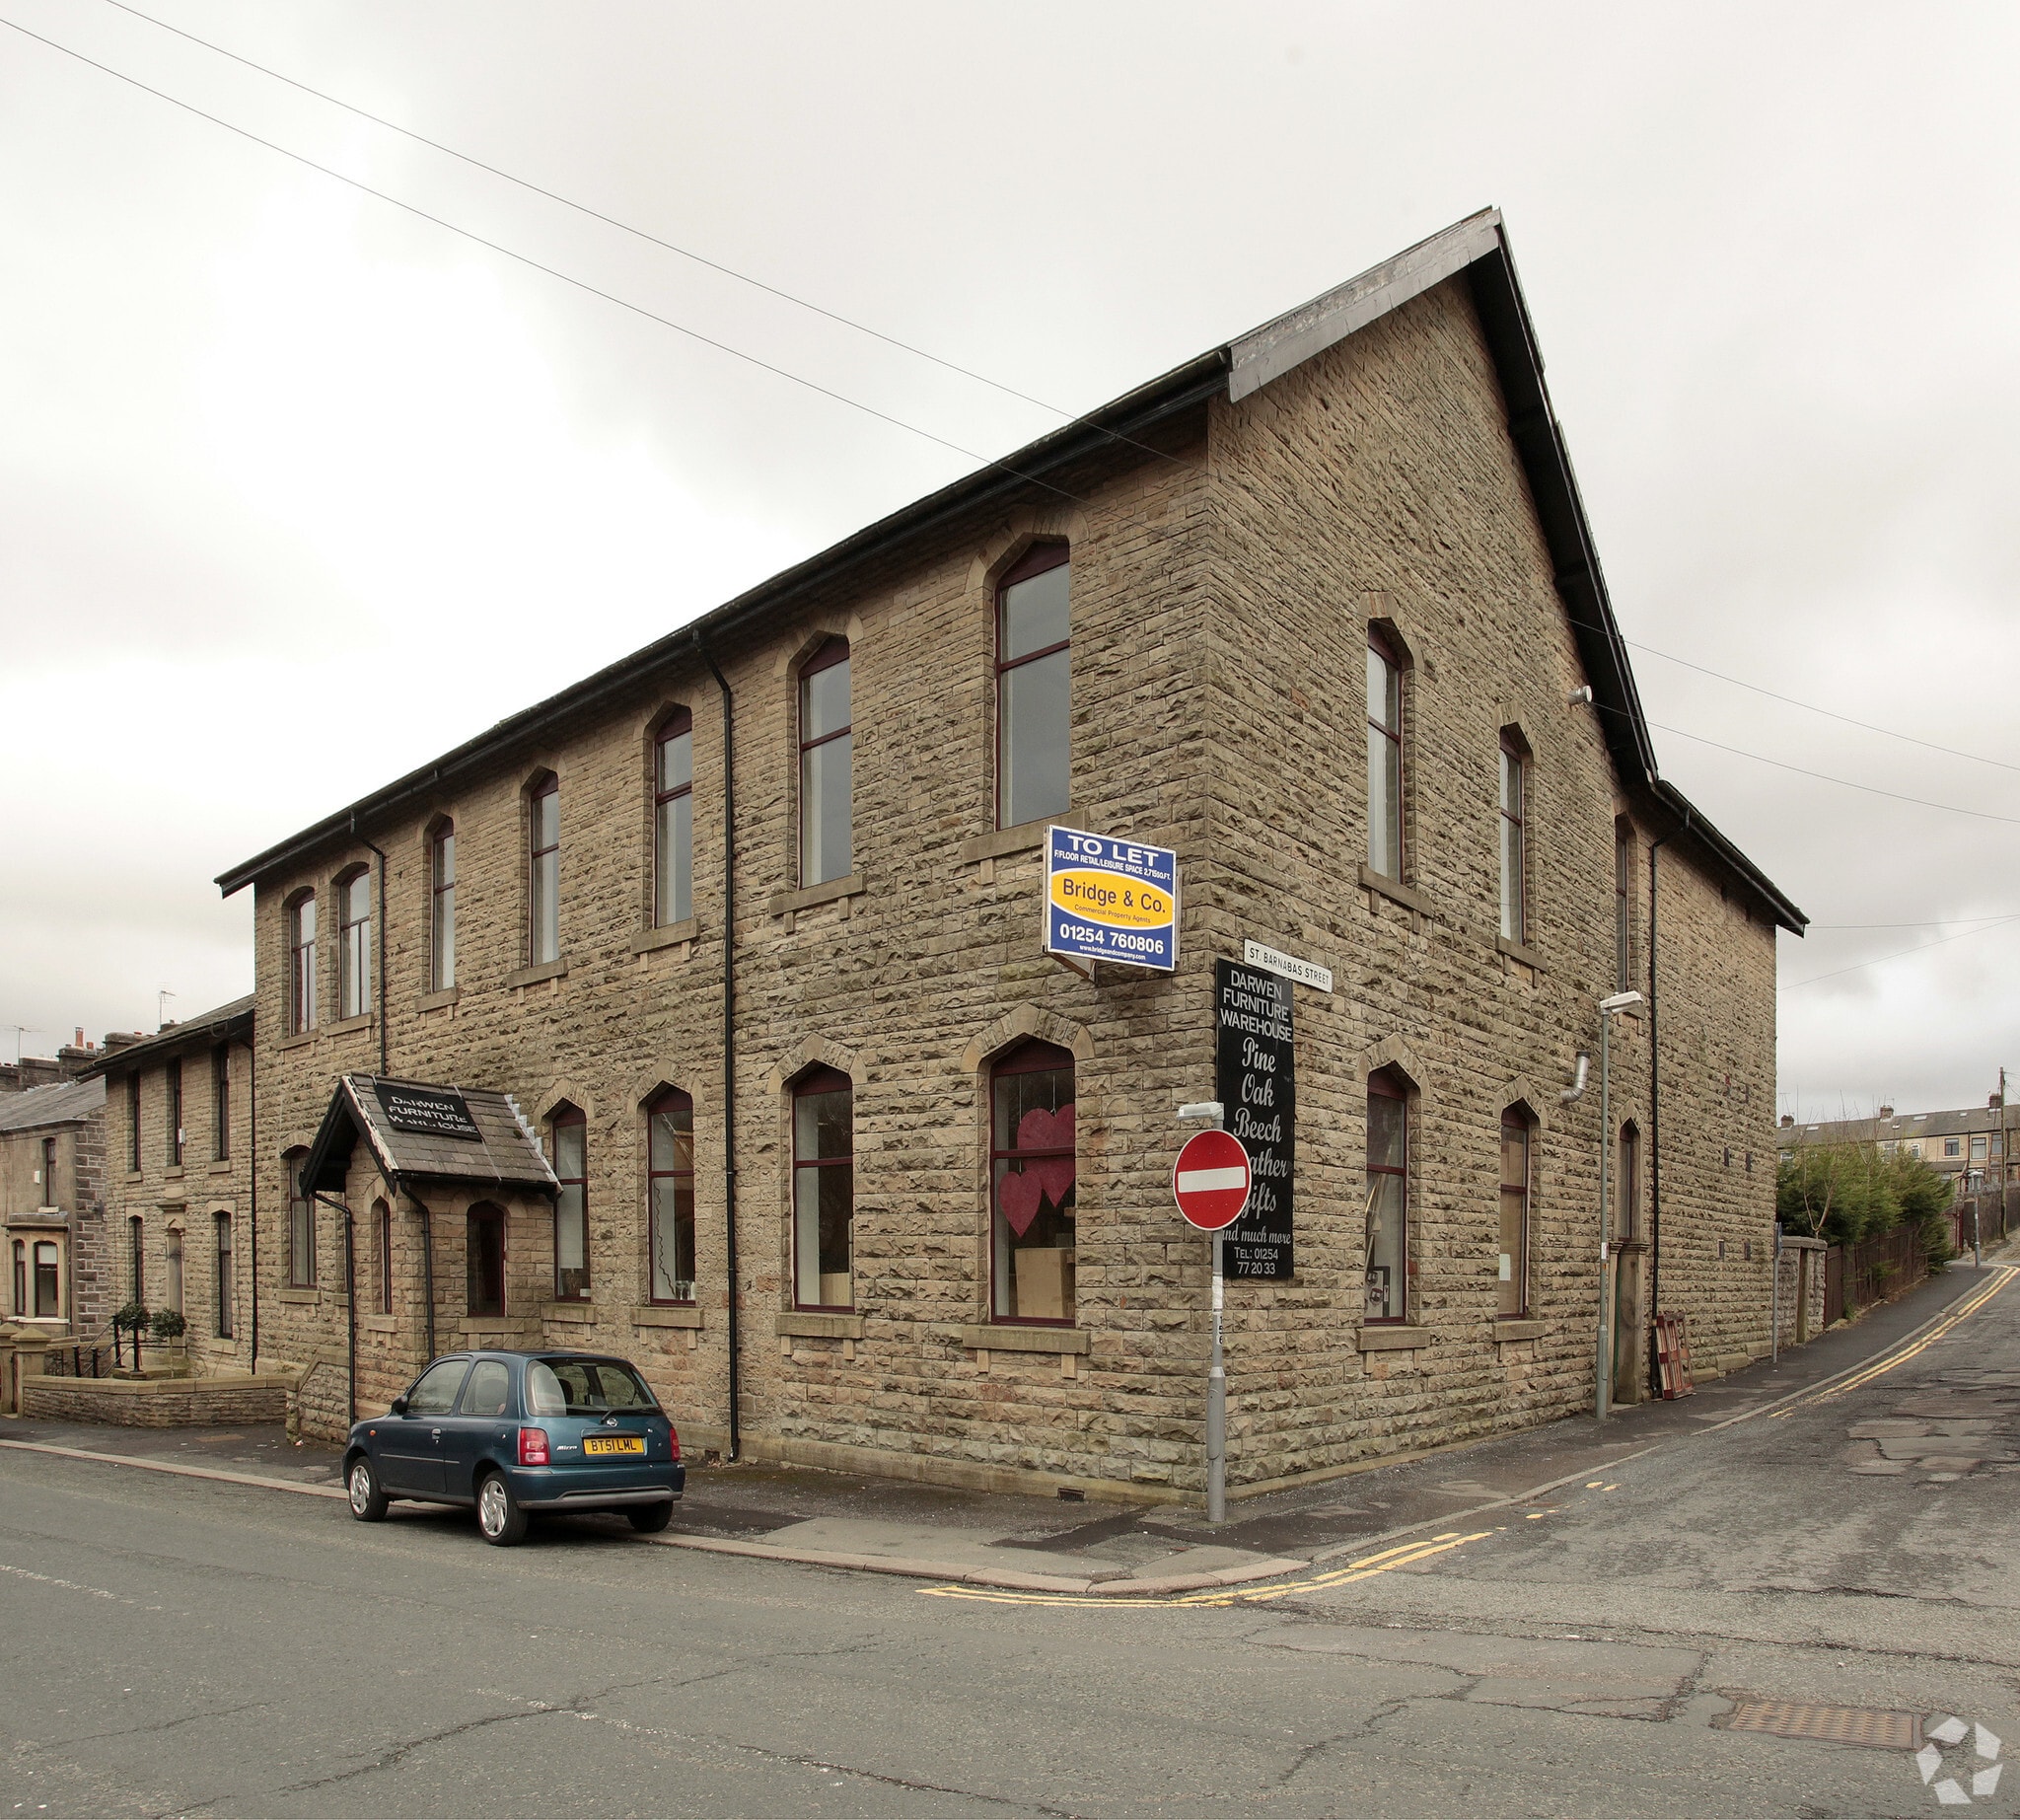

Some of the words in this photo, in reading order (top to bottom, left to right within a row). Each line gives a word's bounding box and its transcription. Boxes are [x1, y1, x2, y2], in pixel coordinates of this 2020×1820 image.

[1067, 835, 1103, 855] TO
[1113, 844, 1159, 867] LET
[1124, 863, 1143, 875] SPACE
[1063, 878, 1117, 907] Bridge
[1123, 890, 1134, 908] &
[1141, 893, 1166, 913] Co.
[1074, 904, 1107, 916] Commercial
[1108, 910, 1131, 920] Property
[1132, 914, 1151, 924] Agents
[1059, 923, 1105, 945] 01254
[1109, 932, 1164, 955] 760806
[1079, 944, 1146, 961] www.bridgeandcompany.com
[1249, 947, 1262, 962] ST.
[1263, 952, 1302, 976] BARNABAS
[1304, 968, 1330, 985] STREET
[1230, 969, 1282, 1000] DARWEN
[1223, 986, 1289, 1023] FURNITURE
[1220, 1007, 1293, 1044] WAREHOUSE
[1242, 1037, 1276, 1073] Pine
[1241, 1072, 1275, 1107] Oak
[388, 1105, 468, 1124] FURNITURE
[1233, 1107, 1282, 1143] Beech
[1241, 1225, 1267, 1243] much
[1268, 1232, 1292, 1245] more
[1254, 1248, 1279, 1261] 01254
